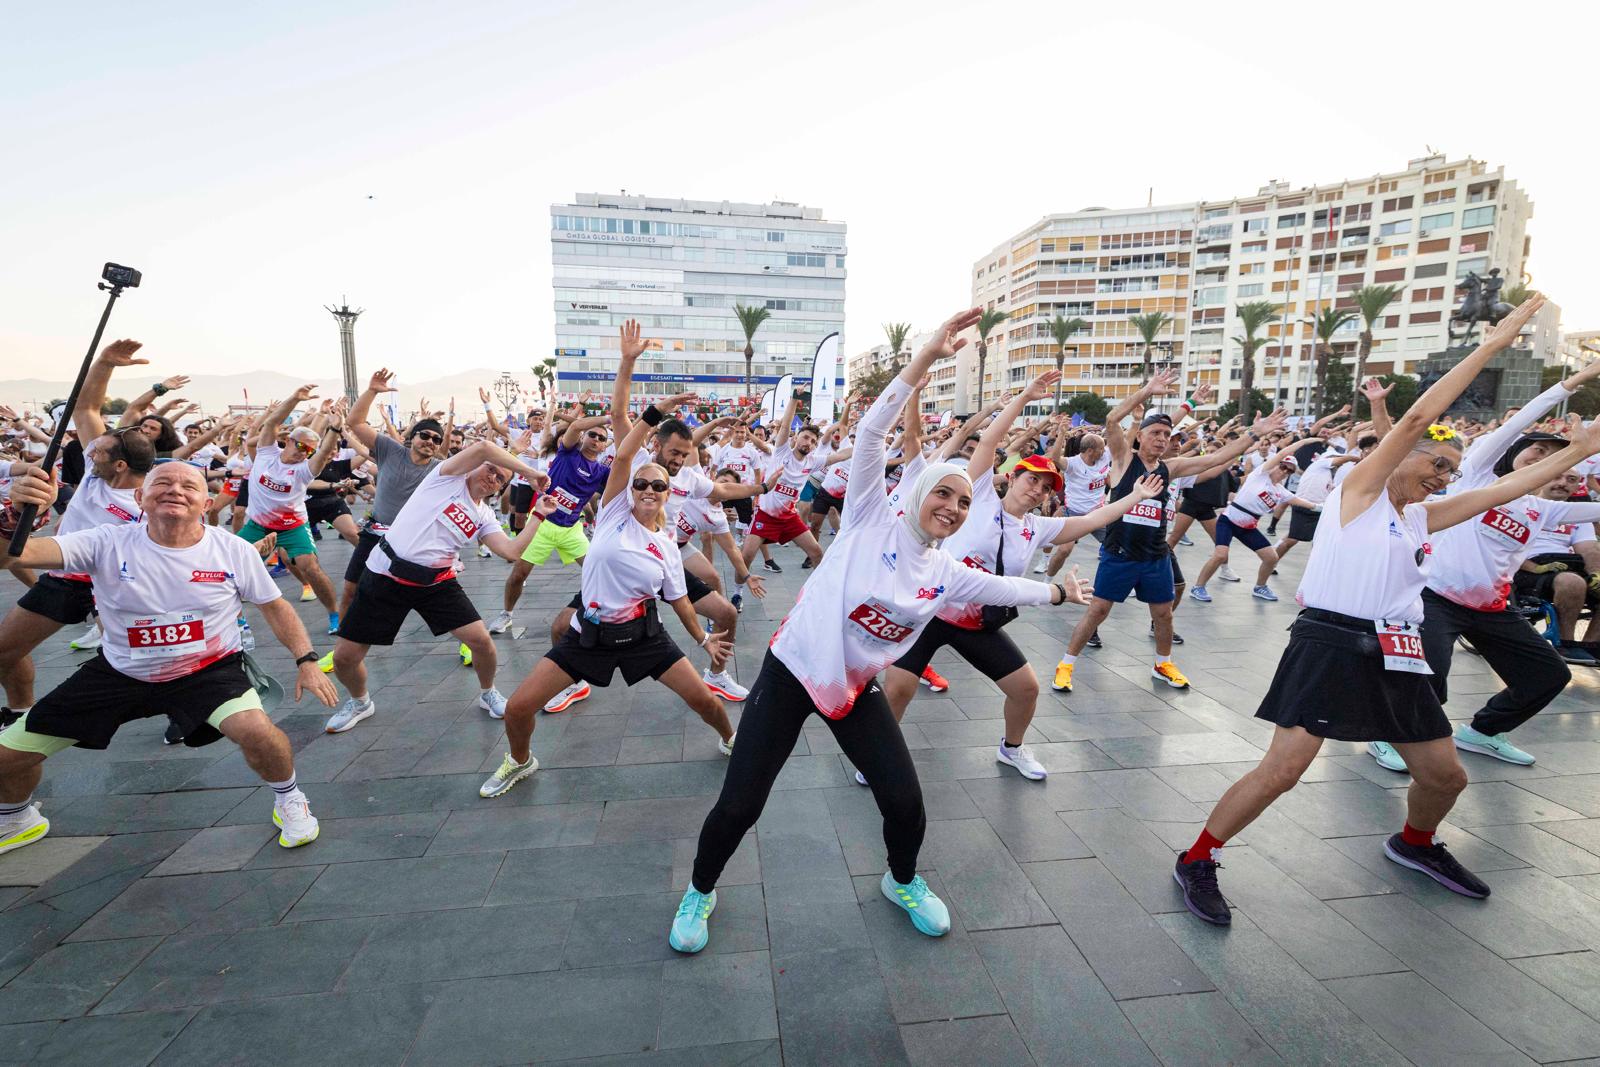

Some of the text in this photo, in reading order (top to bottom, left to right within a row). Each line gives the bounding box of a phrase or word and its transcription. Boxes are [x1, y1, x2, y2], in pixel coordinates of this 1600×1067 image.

[593, 233, 618, 241] GLOBAL
[622, 235, 656, 243] LOGISTICS
[263, 479, 286, 493] 3208
[779, 485, 795, 496] 2313
[448, 507, 474, 532] 2919
[1131, 504, 1157, 518] 1688
[1490, 513, 1526, 539] 1928
[139, 624, 192, 645] 3182
[859, 610, 905, 639] 2265
[1391, 635, 1423, 657] 1199
